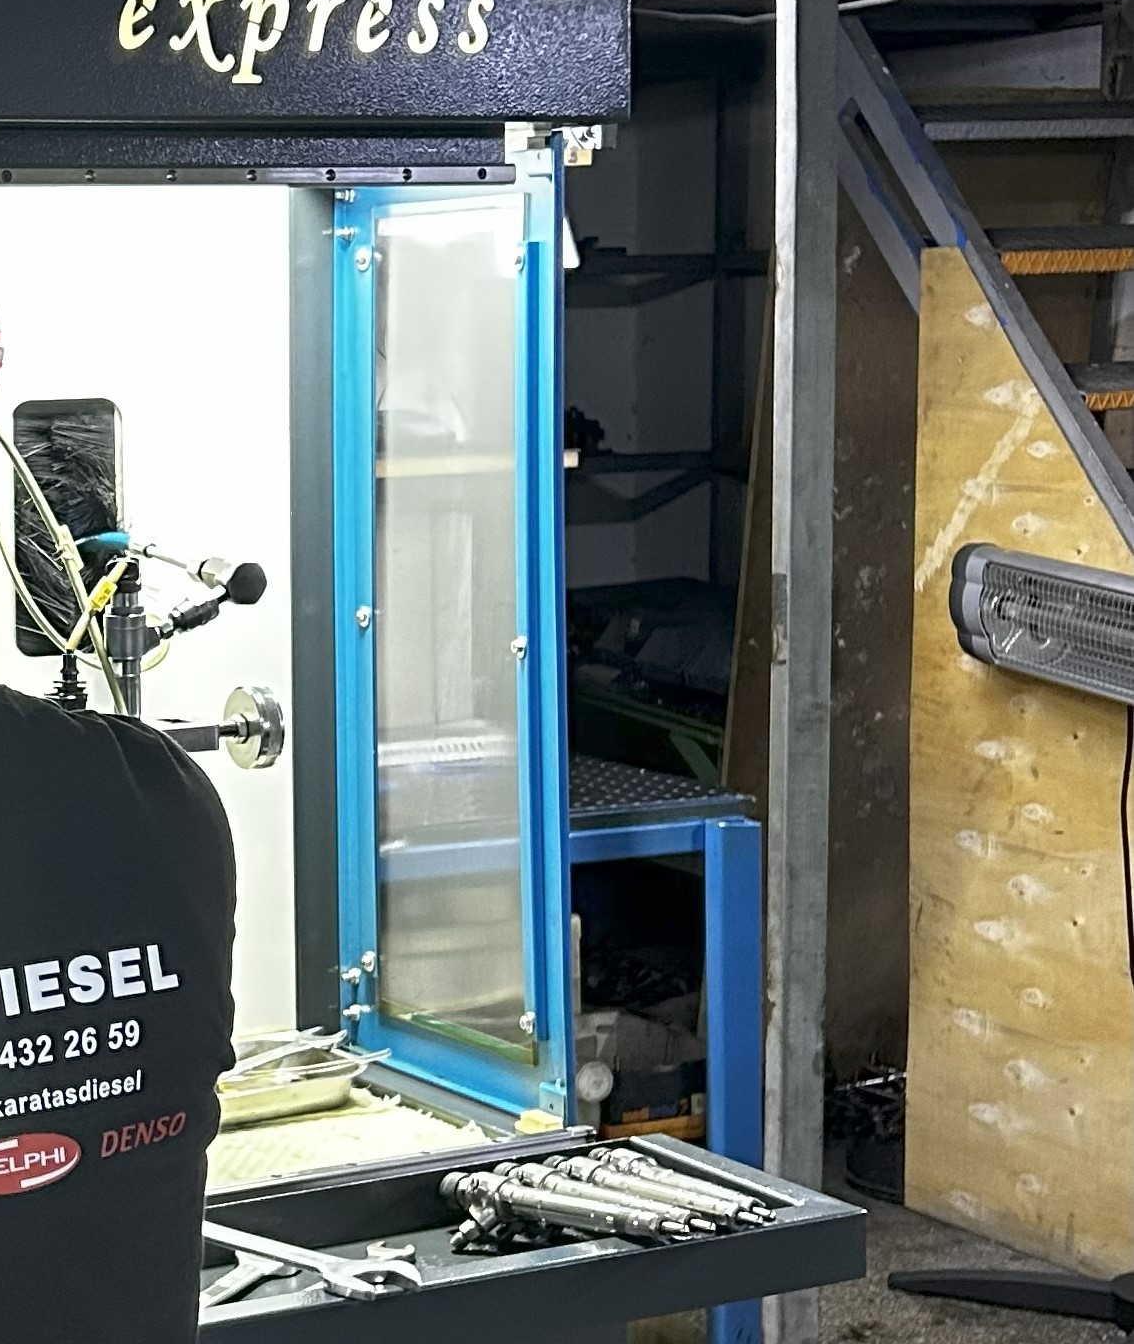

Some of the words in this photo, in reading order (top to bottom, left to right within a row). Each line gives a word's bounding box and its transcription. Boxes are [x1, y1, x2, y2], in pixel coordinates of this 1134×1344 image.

[63, 1026, 98, 1059] 26
[108, 1019, 140, 1050] 59
[101, 1112, 186, 1158] DENSO
